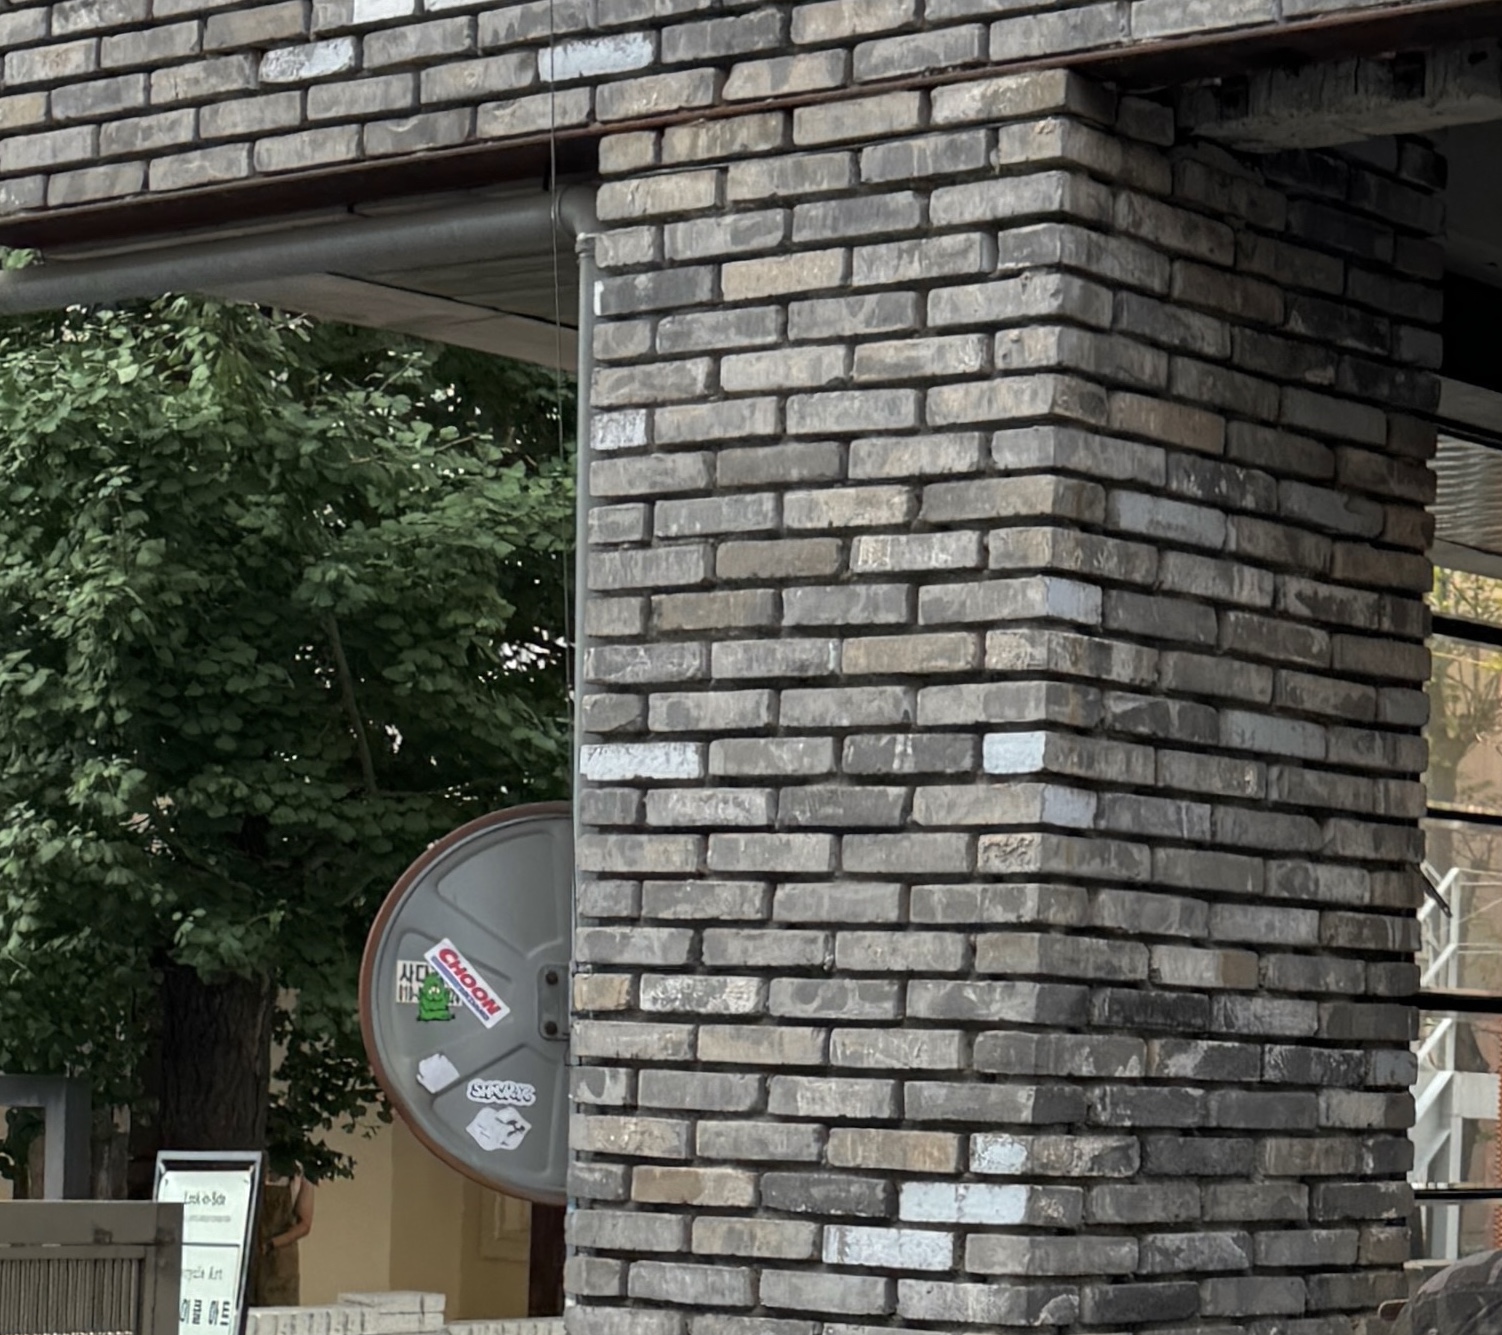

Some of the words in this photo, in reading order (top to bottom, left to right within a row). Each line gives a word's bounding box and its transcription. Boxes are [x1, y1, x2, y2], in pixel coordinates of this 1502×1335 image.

[438, 948, 502, 1016] CHOON
[180, 1298, 202, 1325] 이클
[208, 1300, 231, 1326] 아트
